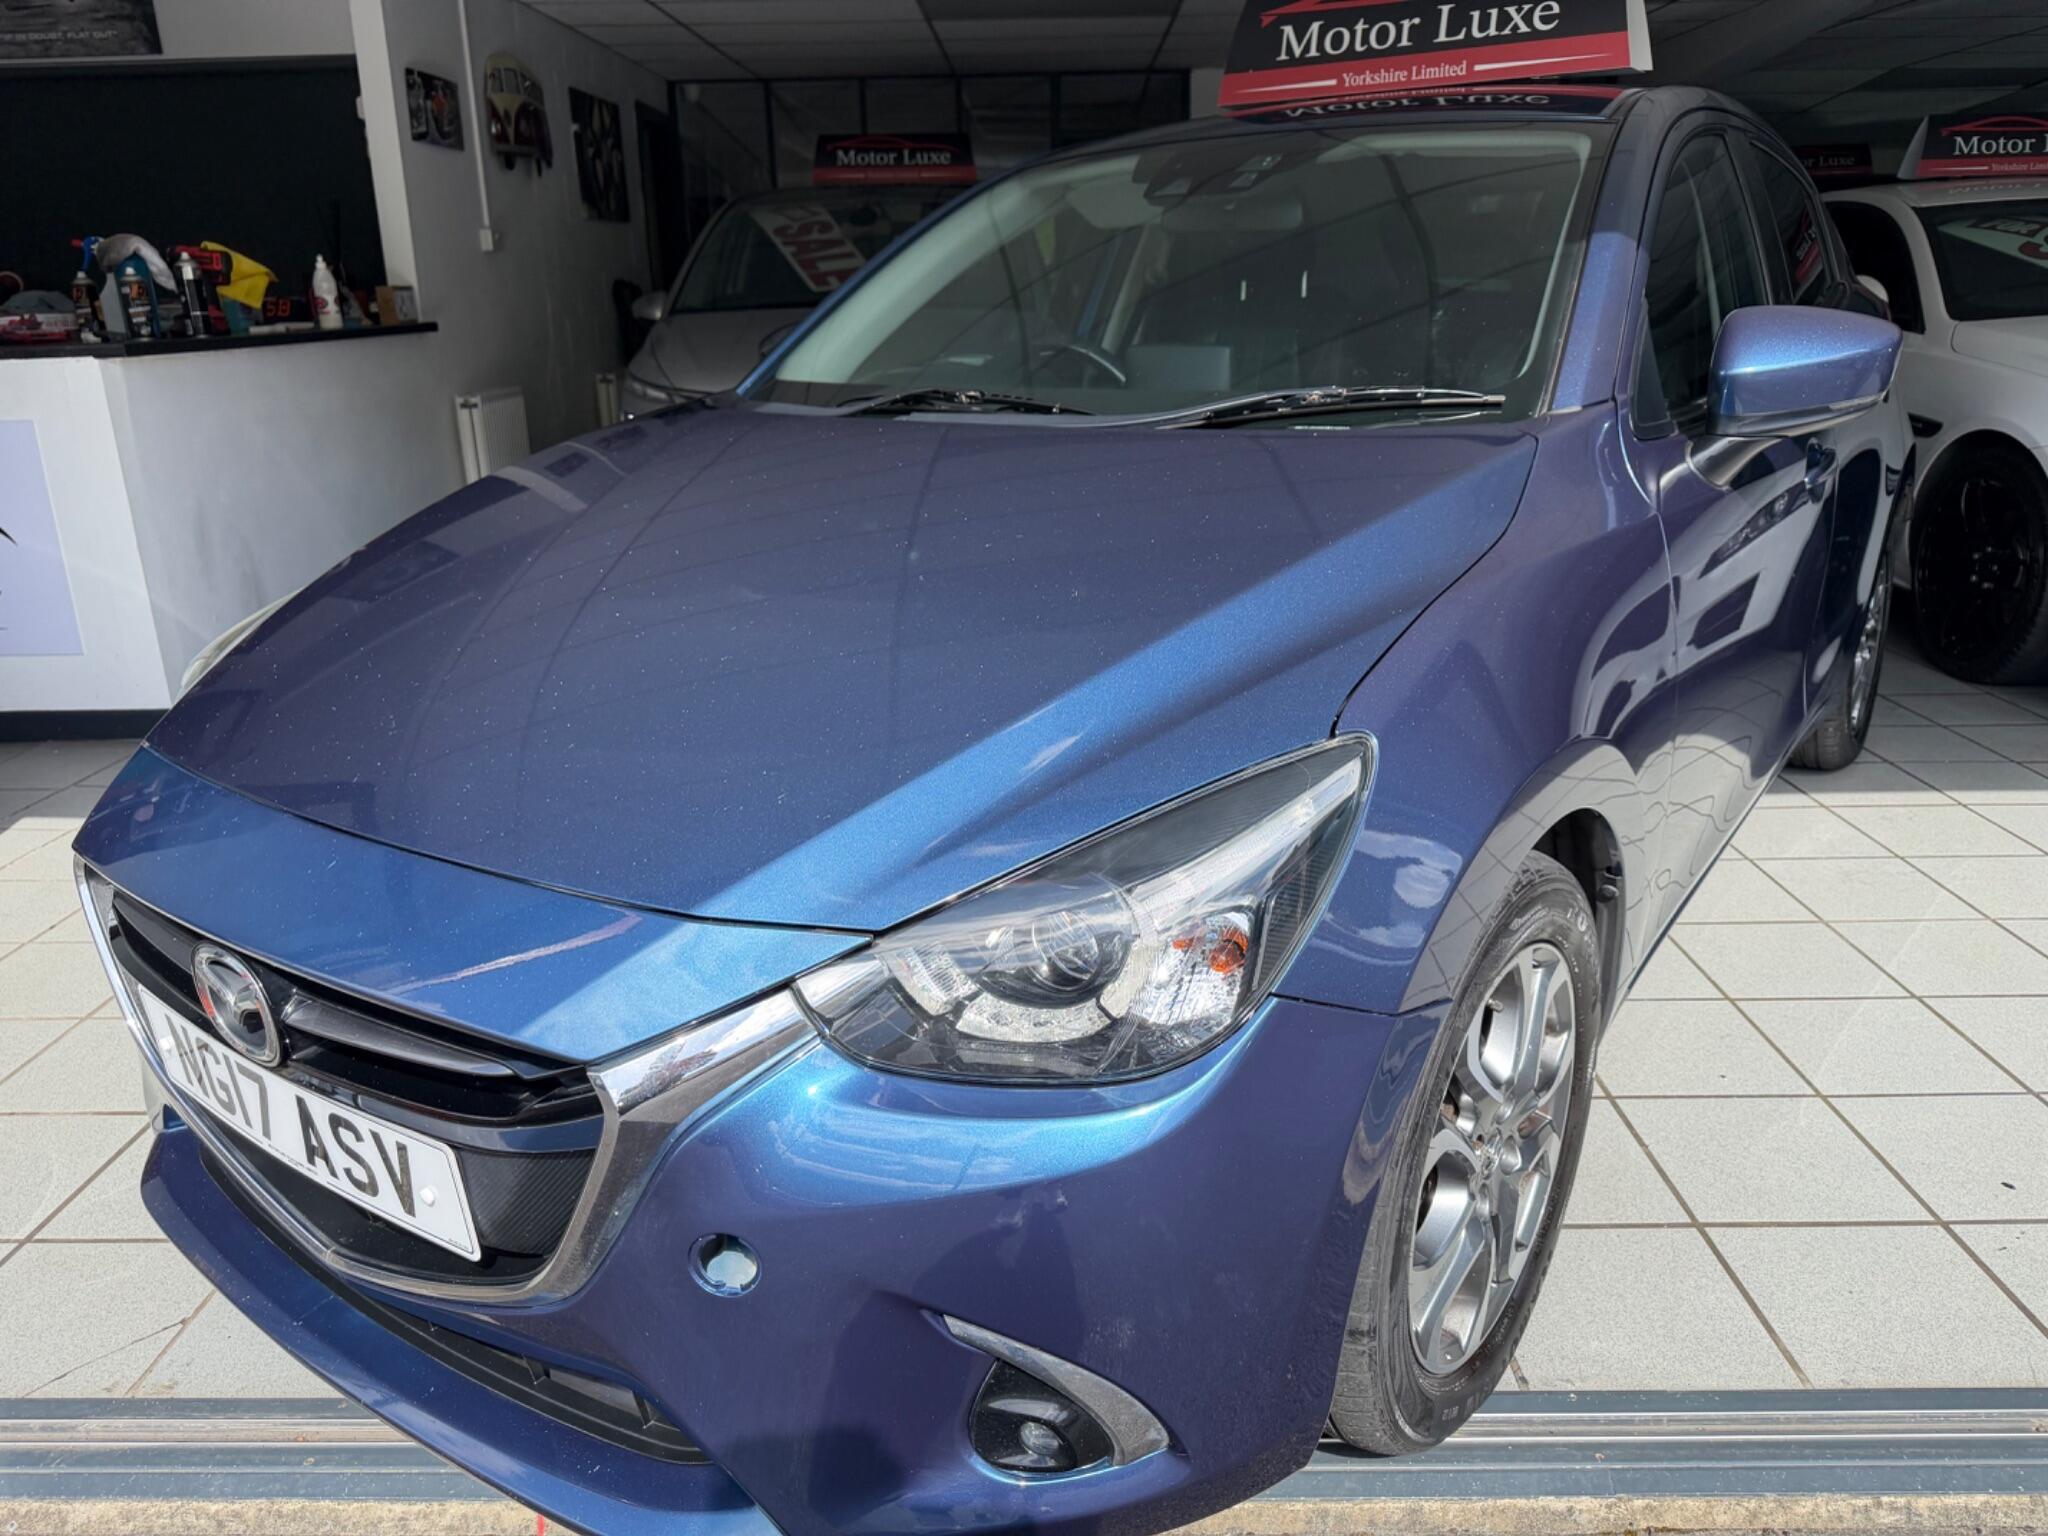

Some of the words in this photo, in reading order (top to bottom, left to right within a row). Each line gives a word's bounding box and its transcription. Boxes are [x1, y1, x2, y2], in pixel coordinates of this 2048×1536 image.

[1276, 18, 1419, 61] Motor
[1433, 0, 1561, 43] Luxe
[1342, 66, 1408, 87] Yorkshire
[1412, 61, 1467, 80] Limited
[835, 149, 898, 167] Motor
[902, 148, 952, 165] Luxe
[1952, 135, 2036, 156] Motor
[165, 1013, 272, 1141] NG17
[295, 1093, 417, 1218] ASV
